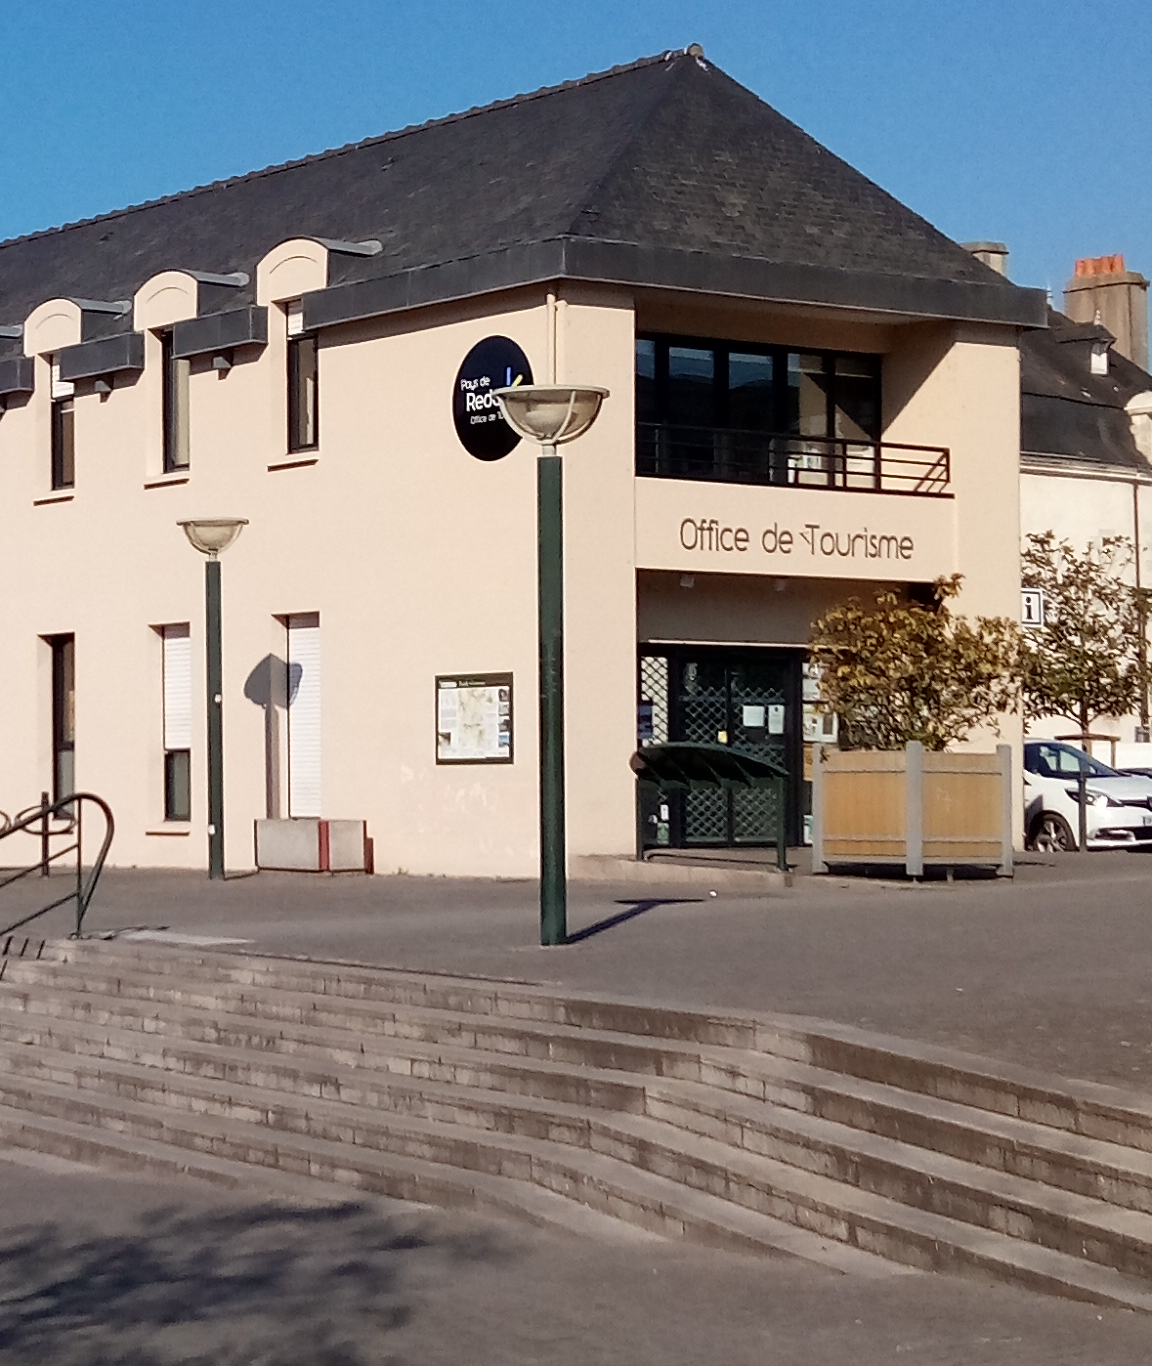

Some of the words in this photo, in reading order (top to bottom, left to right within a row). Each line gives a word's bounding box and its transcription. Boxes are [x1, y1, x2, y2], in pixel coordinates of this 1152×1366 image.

[461, 379, 478, 391] Pays
[480, 376, 490, 387] de
[680, 518, 749, 552] Office
[762, 522, 793, 554] de
[799, 524, 914, 560] Tourisme
[1025, 596, 1034, 620] i
